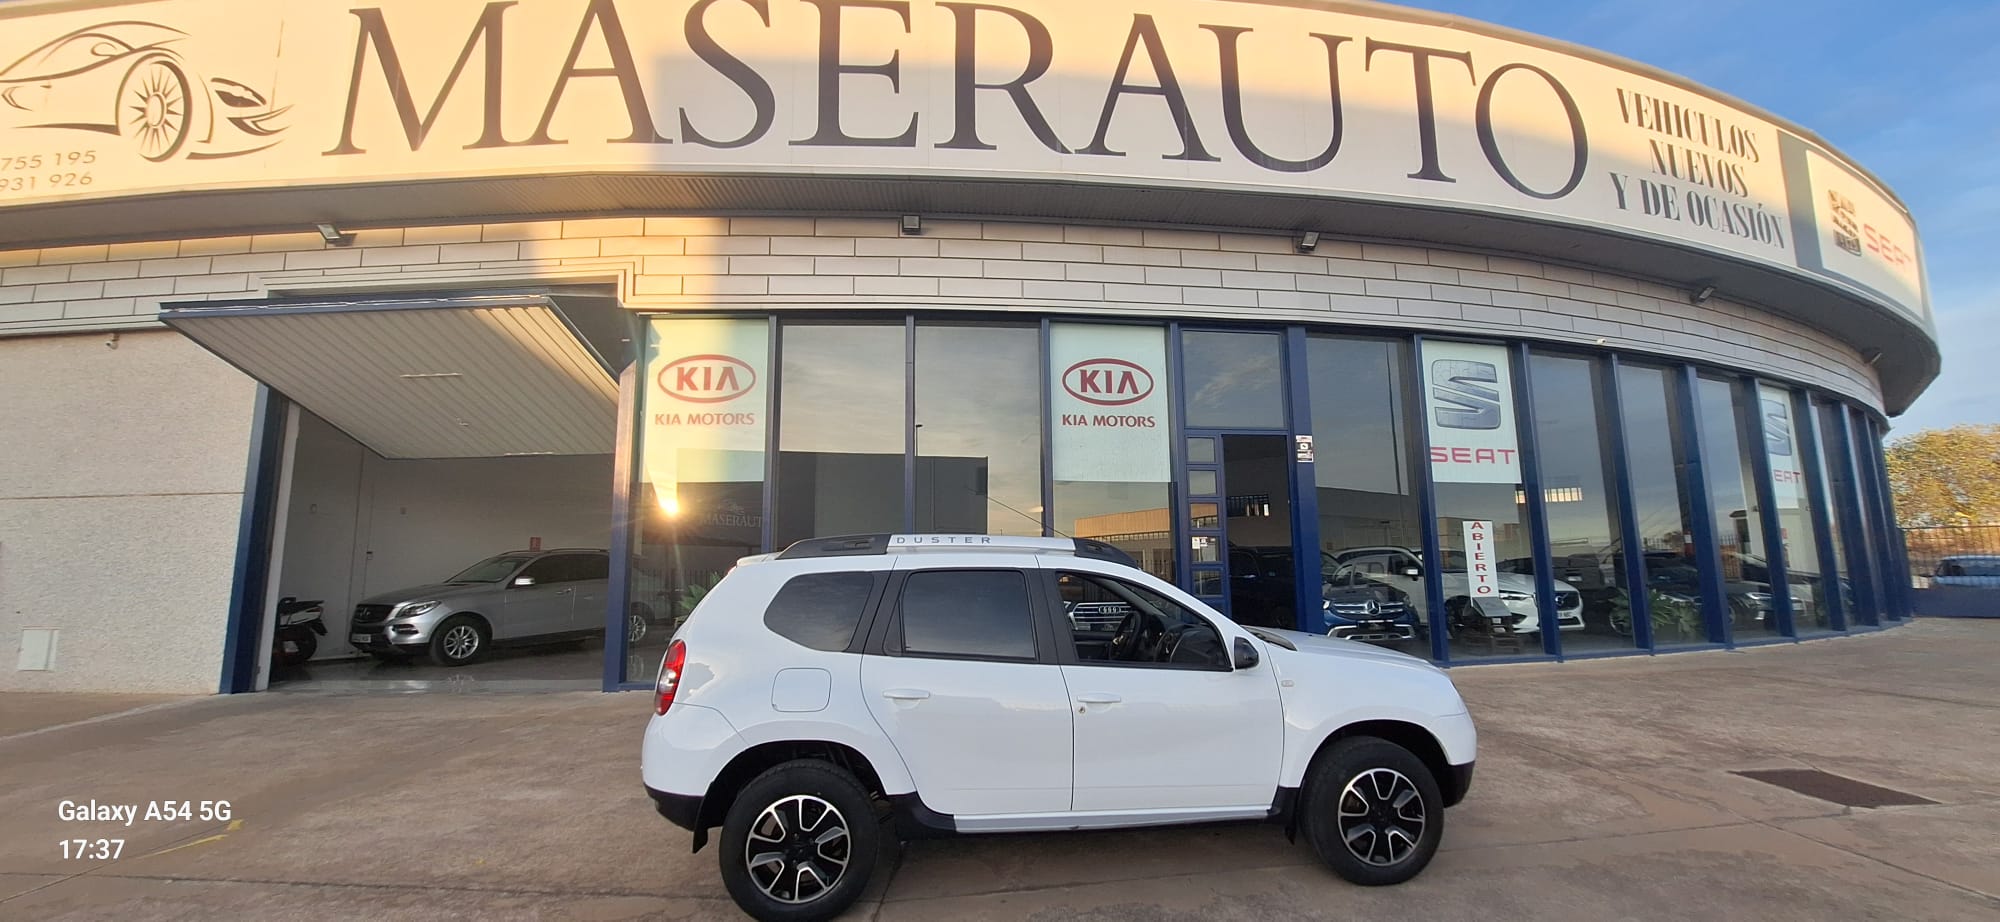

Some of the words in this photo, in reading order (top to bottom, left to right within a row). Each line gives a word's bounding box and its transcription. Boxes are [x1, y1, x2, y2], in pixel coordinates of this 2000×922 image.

[321, 0, 1589, 200] MASERAUTO
[1616, 88, 1760, 163] VEHICULOS
[1, 154, 42, 171] 755
[56, 150, 96, 165] 195
[1649, 139, 1748, 198] NUEVOS
[49, 172, 92, 188] 926
[1608, 172, 1630, 210] Y
[1640, 179, 1681, 221] DE
[1686, 190, 1785, 249] OCASIÓN
[676, 366, 740, 392] KIA
[1080, 369, 1139, 395] KIA
[655, 413, 682, 426] KIA
[687, 412, 755, 426] MOTORS
[1062, 414, 1088, 426] KIA
[1093, 415, 1156, 428] MOTORS
[1430, 447, 1515, 465] SEAT
[1773, 469, 1801, 483] EAT
[704, 511, 763, 527] MASERAUT
[896, 536, 992, 544] DUSTER
[1471, 521, 1492, 594] ABIERTO
